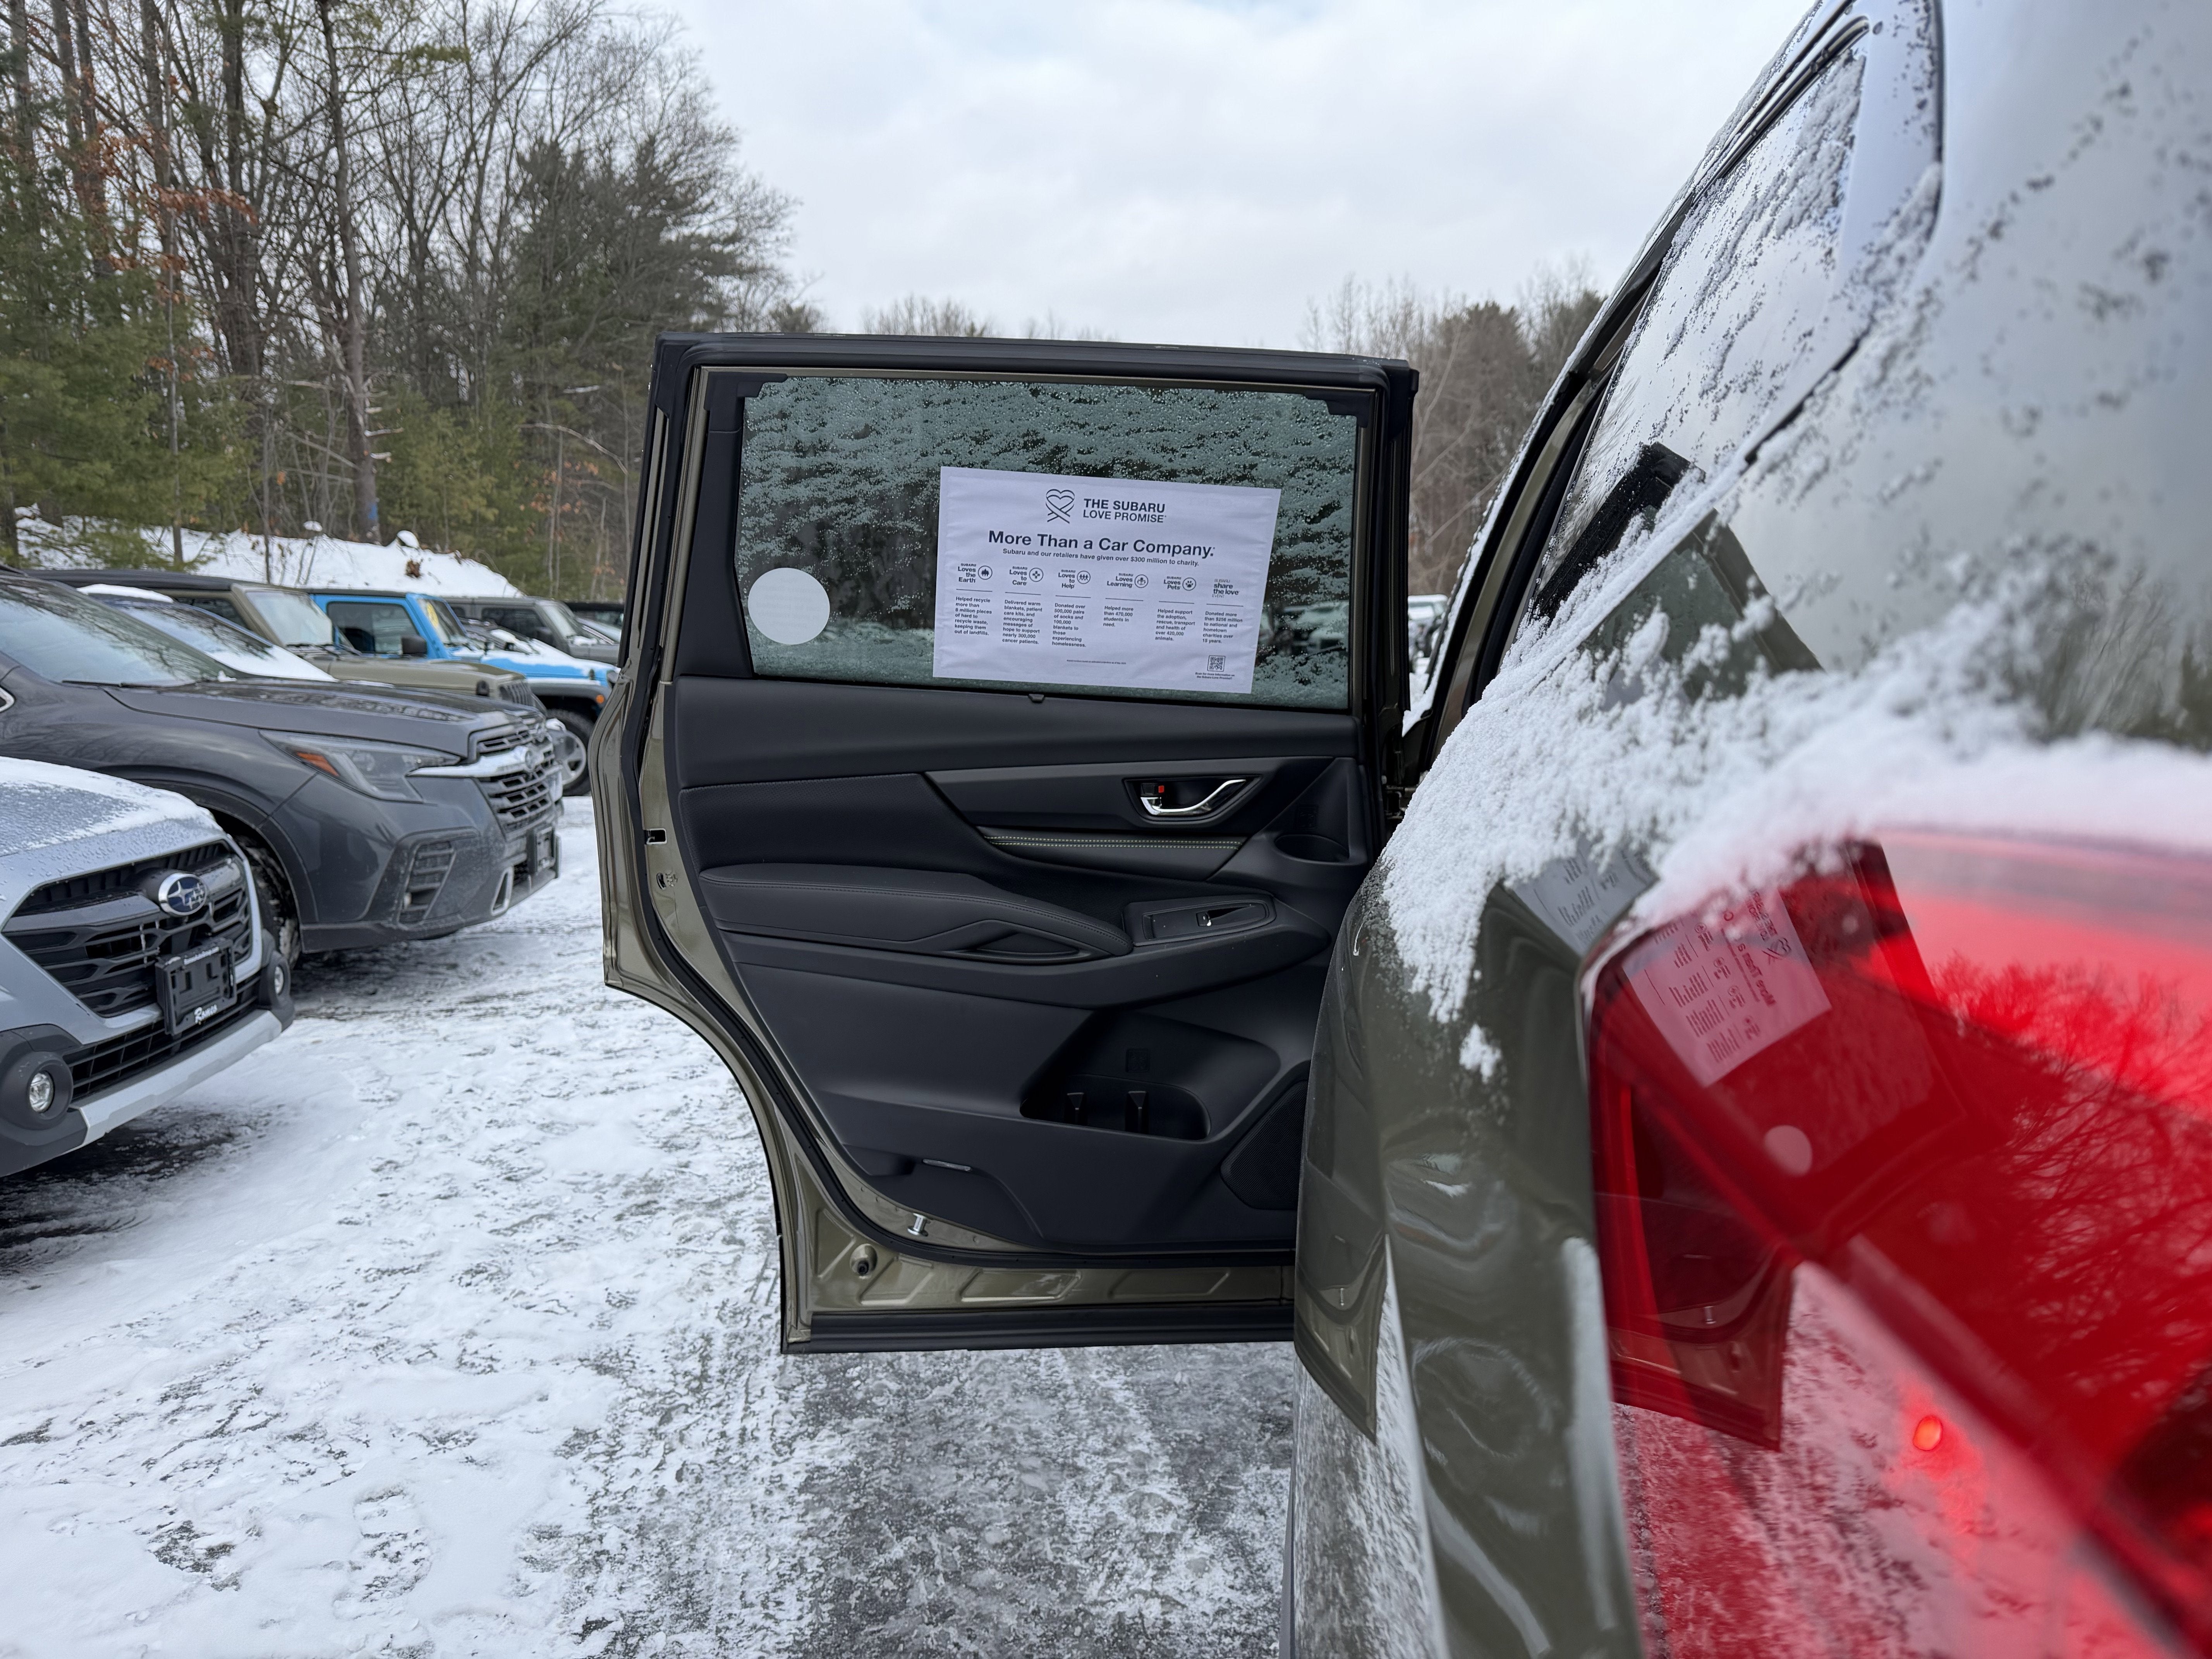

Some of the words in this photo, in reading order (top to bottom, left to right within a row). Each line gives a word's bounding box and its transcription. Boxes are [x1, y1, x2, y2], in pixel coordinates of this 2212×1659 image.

[1084, 498, 1109, 509] THE
[1113, 501, 1165, 513] SUBARU
[1083, 509, 1111, 519] LOVE
[1115, 512, 1164, 523] PROMISE
[989, 531, 1031, 545] More
[1037, 534, 1078, 548] Than
[1084, 540, 1092, 549] a
[1099, 538, 1128, 551] Car
